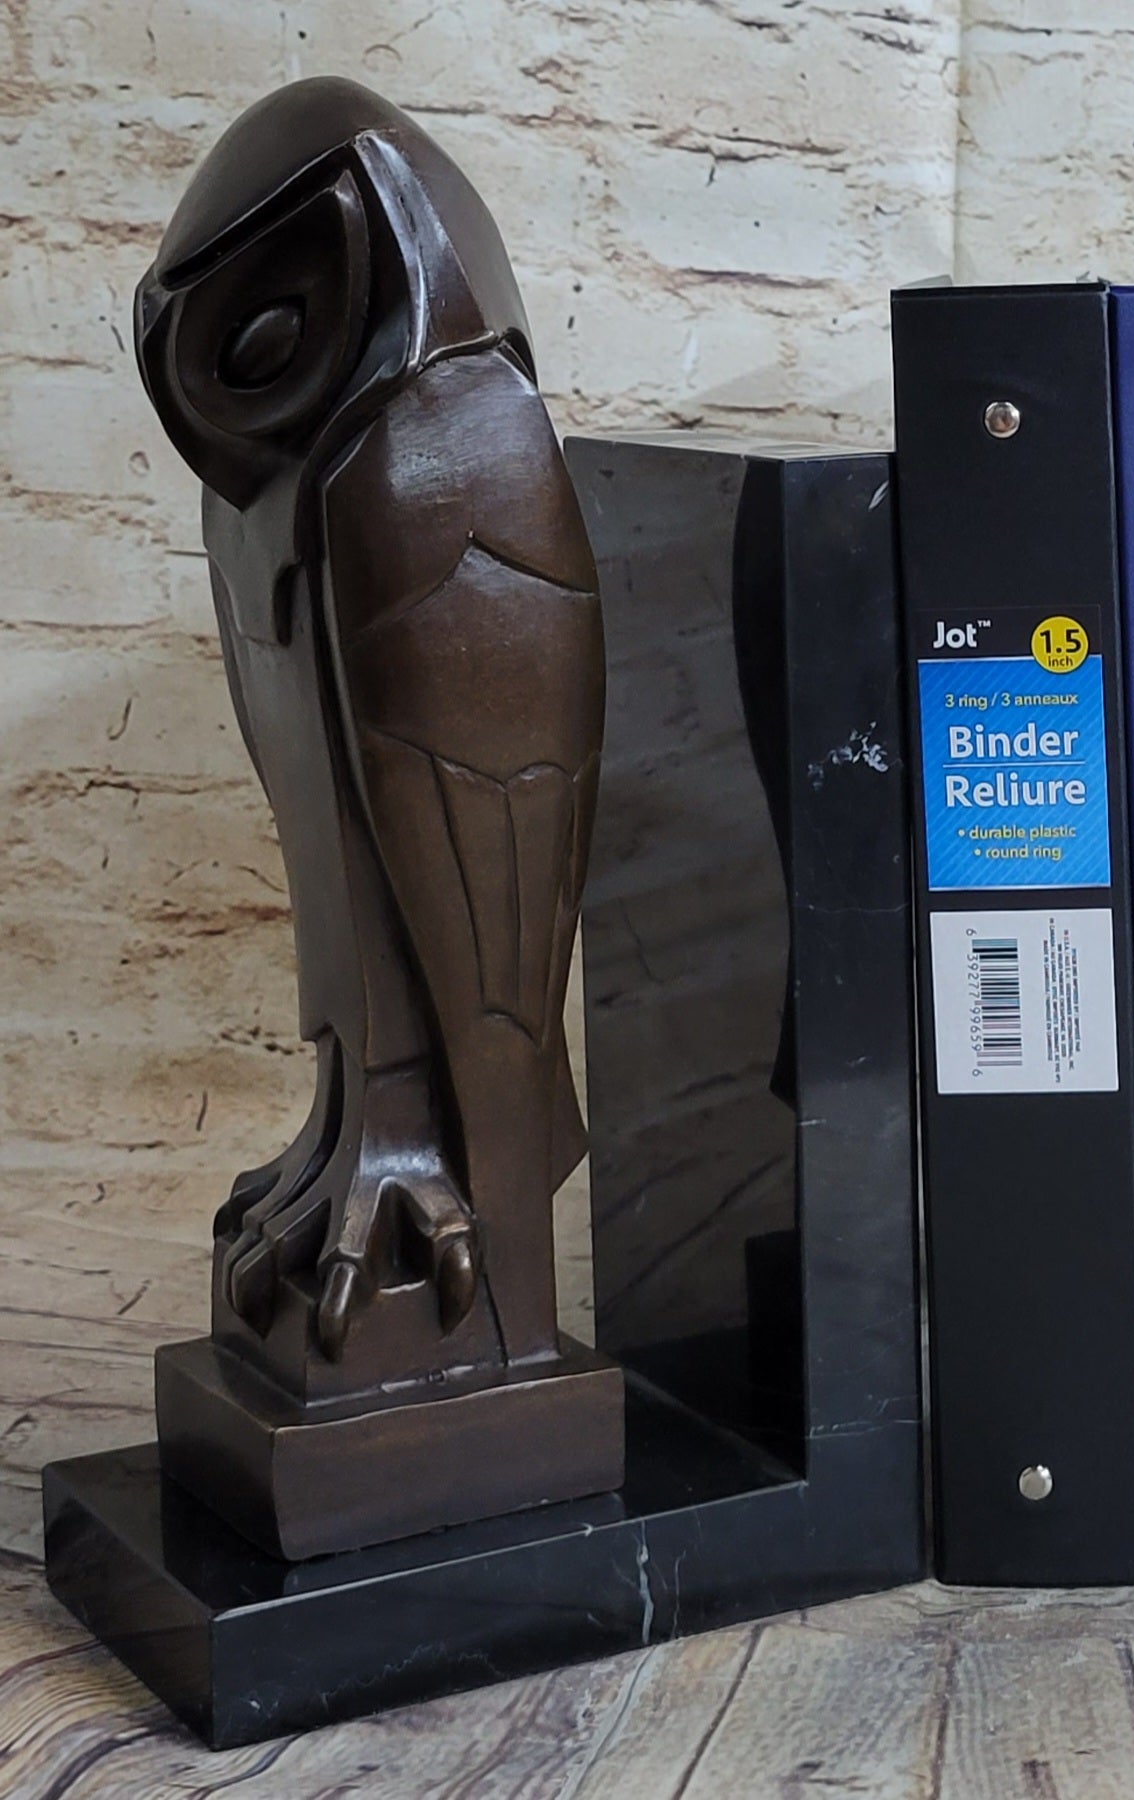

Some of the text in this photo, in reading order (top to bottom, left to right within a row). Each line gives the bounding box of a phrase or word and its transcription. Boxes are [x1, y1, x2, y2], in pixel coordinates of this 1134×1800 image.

[1040, 629, 1082, 654] 1.5
[1048, 656, 1073, 667] inch
[945, 694, 955, 707] 3
[959, 693, 987, 710] ring
[1002, 692, 1011, 706] 3
[1015, 693, 1078, 706] anneaux
[949, 723, 1079, 759] Binder
[946, 772, 1086, 807] Reliure
[969, 824, 1076, 840] durable plastic
[985, 845, 1061, 860] round ring
[966, 954, 980, 998] 39277
[969, 1007, 982, 1051] 99659
